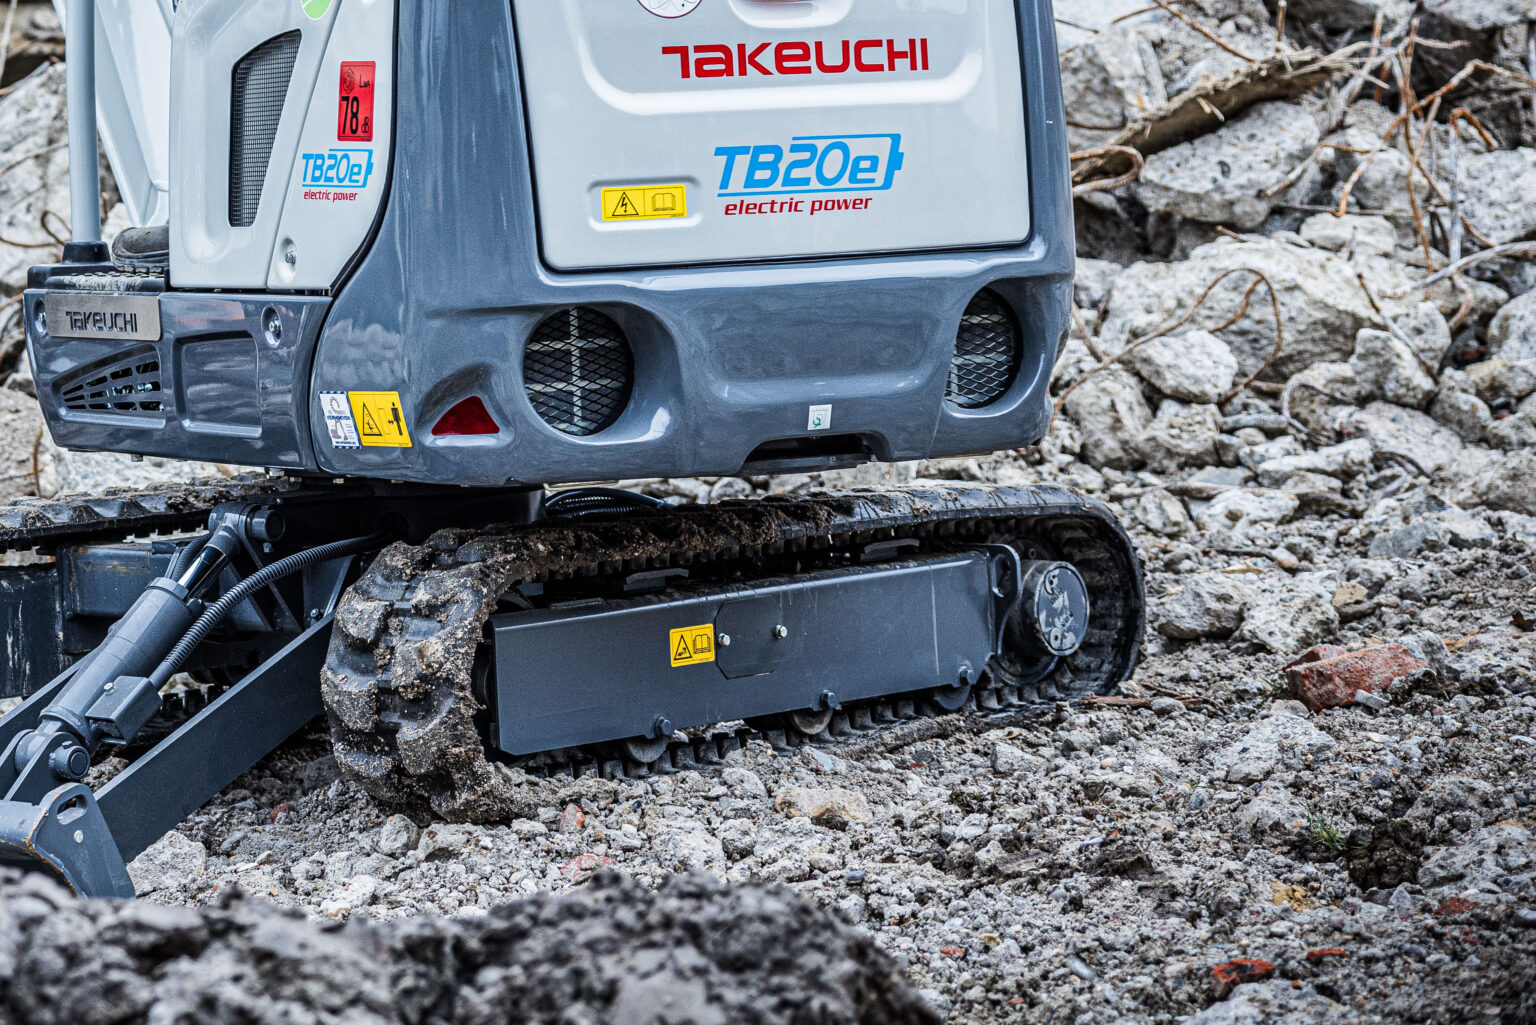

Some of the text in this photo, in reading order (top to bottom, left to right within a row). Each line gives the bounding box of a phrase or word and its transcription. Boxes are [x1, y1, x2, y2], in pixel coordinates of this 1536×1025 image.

[662, 38, 929, 78] TAKEUCHI
[341, 96, 359, 134] 78
[302, 153, 362, 183] TB20e
[714, 141, 879, 190] TB20e
[303, 189, 358, 203] electric power
[724, 197, 873, 215] electric power
[66, 311, 138, 332] TAKEUCHI
